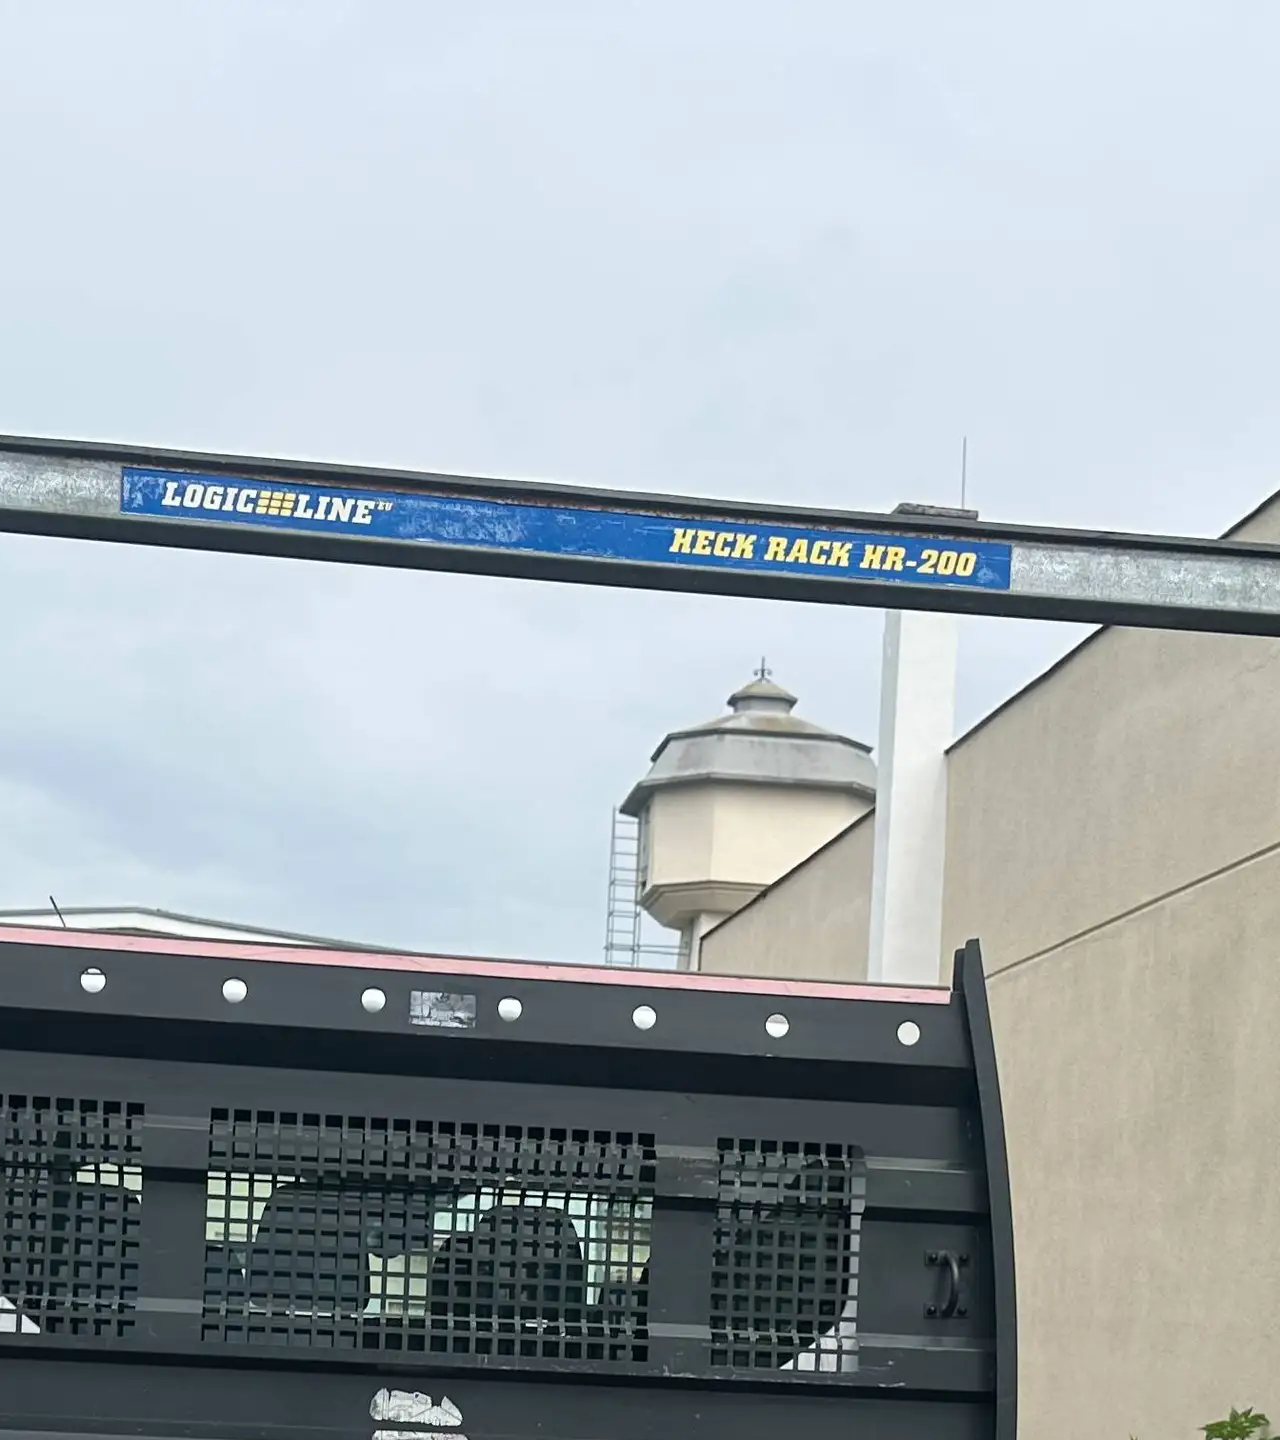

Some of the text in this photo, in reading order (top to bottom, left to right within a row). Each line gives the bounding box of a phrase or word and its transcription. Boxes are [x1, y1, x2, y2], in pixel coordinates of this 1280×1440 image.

[669, 527, 977, 577] HECK RACK HR-200
